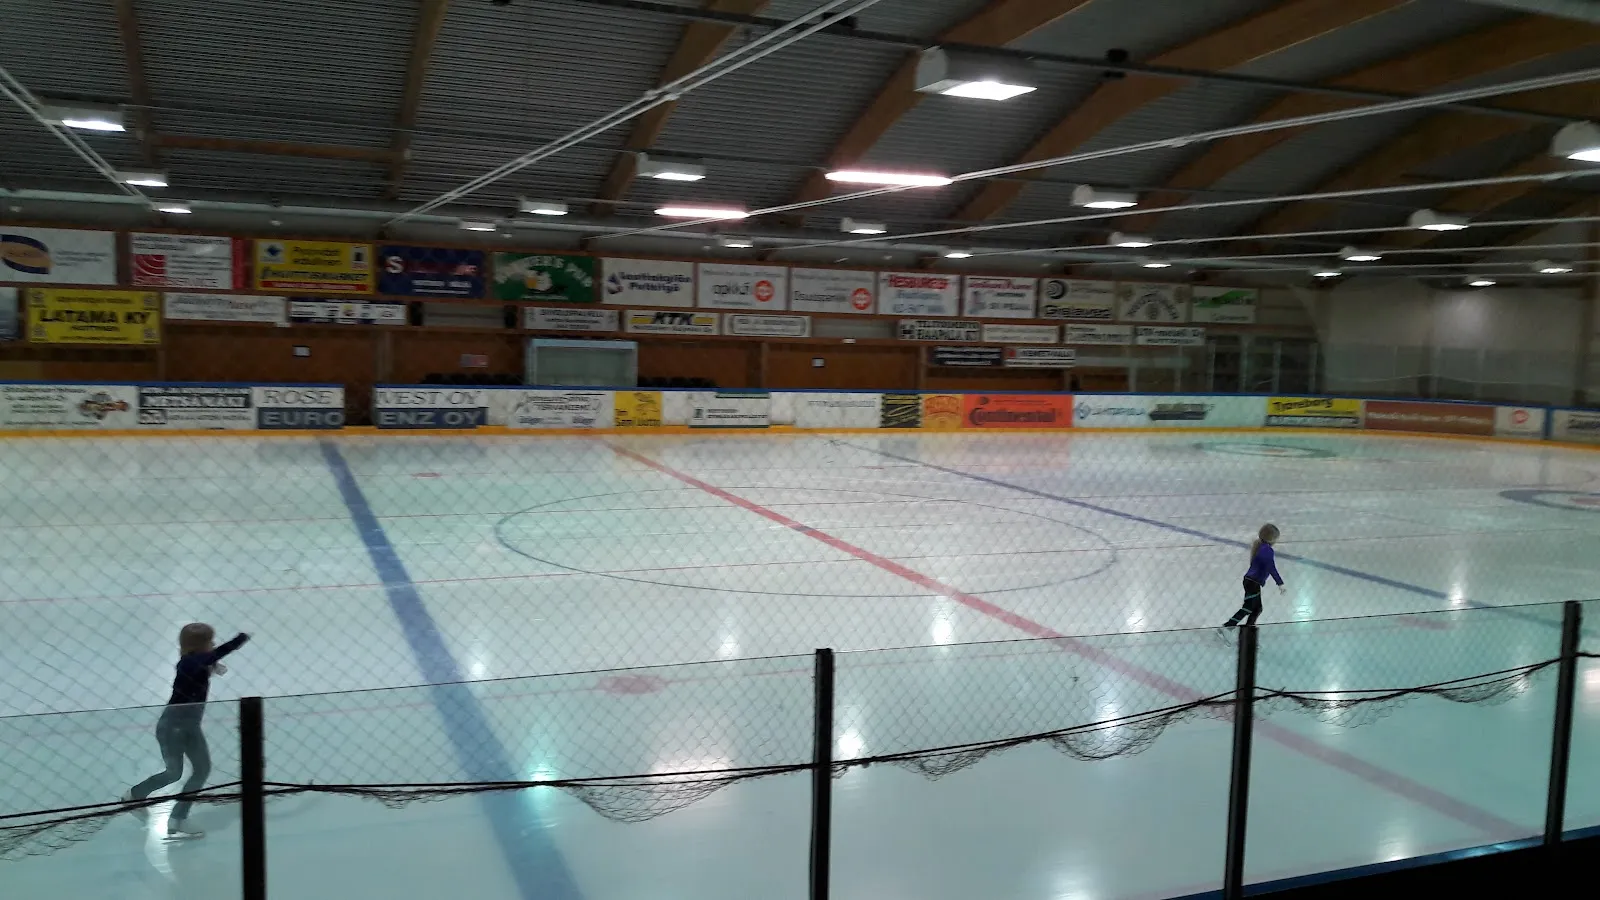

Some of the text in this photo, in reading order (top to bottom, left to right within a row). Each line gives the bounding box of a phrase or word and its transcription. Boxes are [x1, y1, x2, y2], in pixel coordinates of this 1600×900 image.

[39, 308, 149, 324] LATAMA KY
[655, 311, 694, 325] KTK
[263, 389, 334, 405] ROSE
[447, 391, 482, 406] OY
[263, 410, 344, 426] EURO
[380, 410, 482, 426] ENZ OY
[968, 406, 1057, 427] Continental
